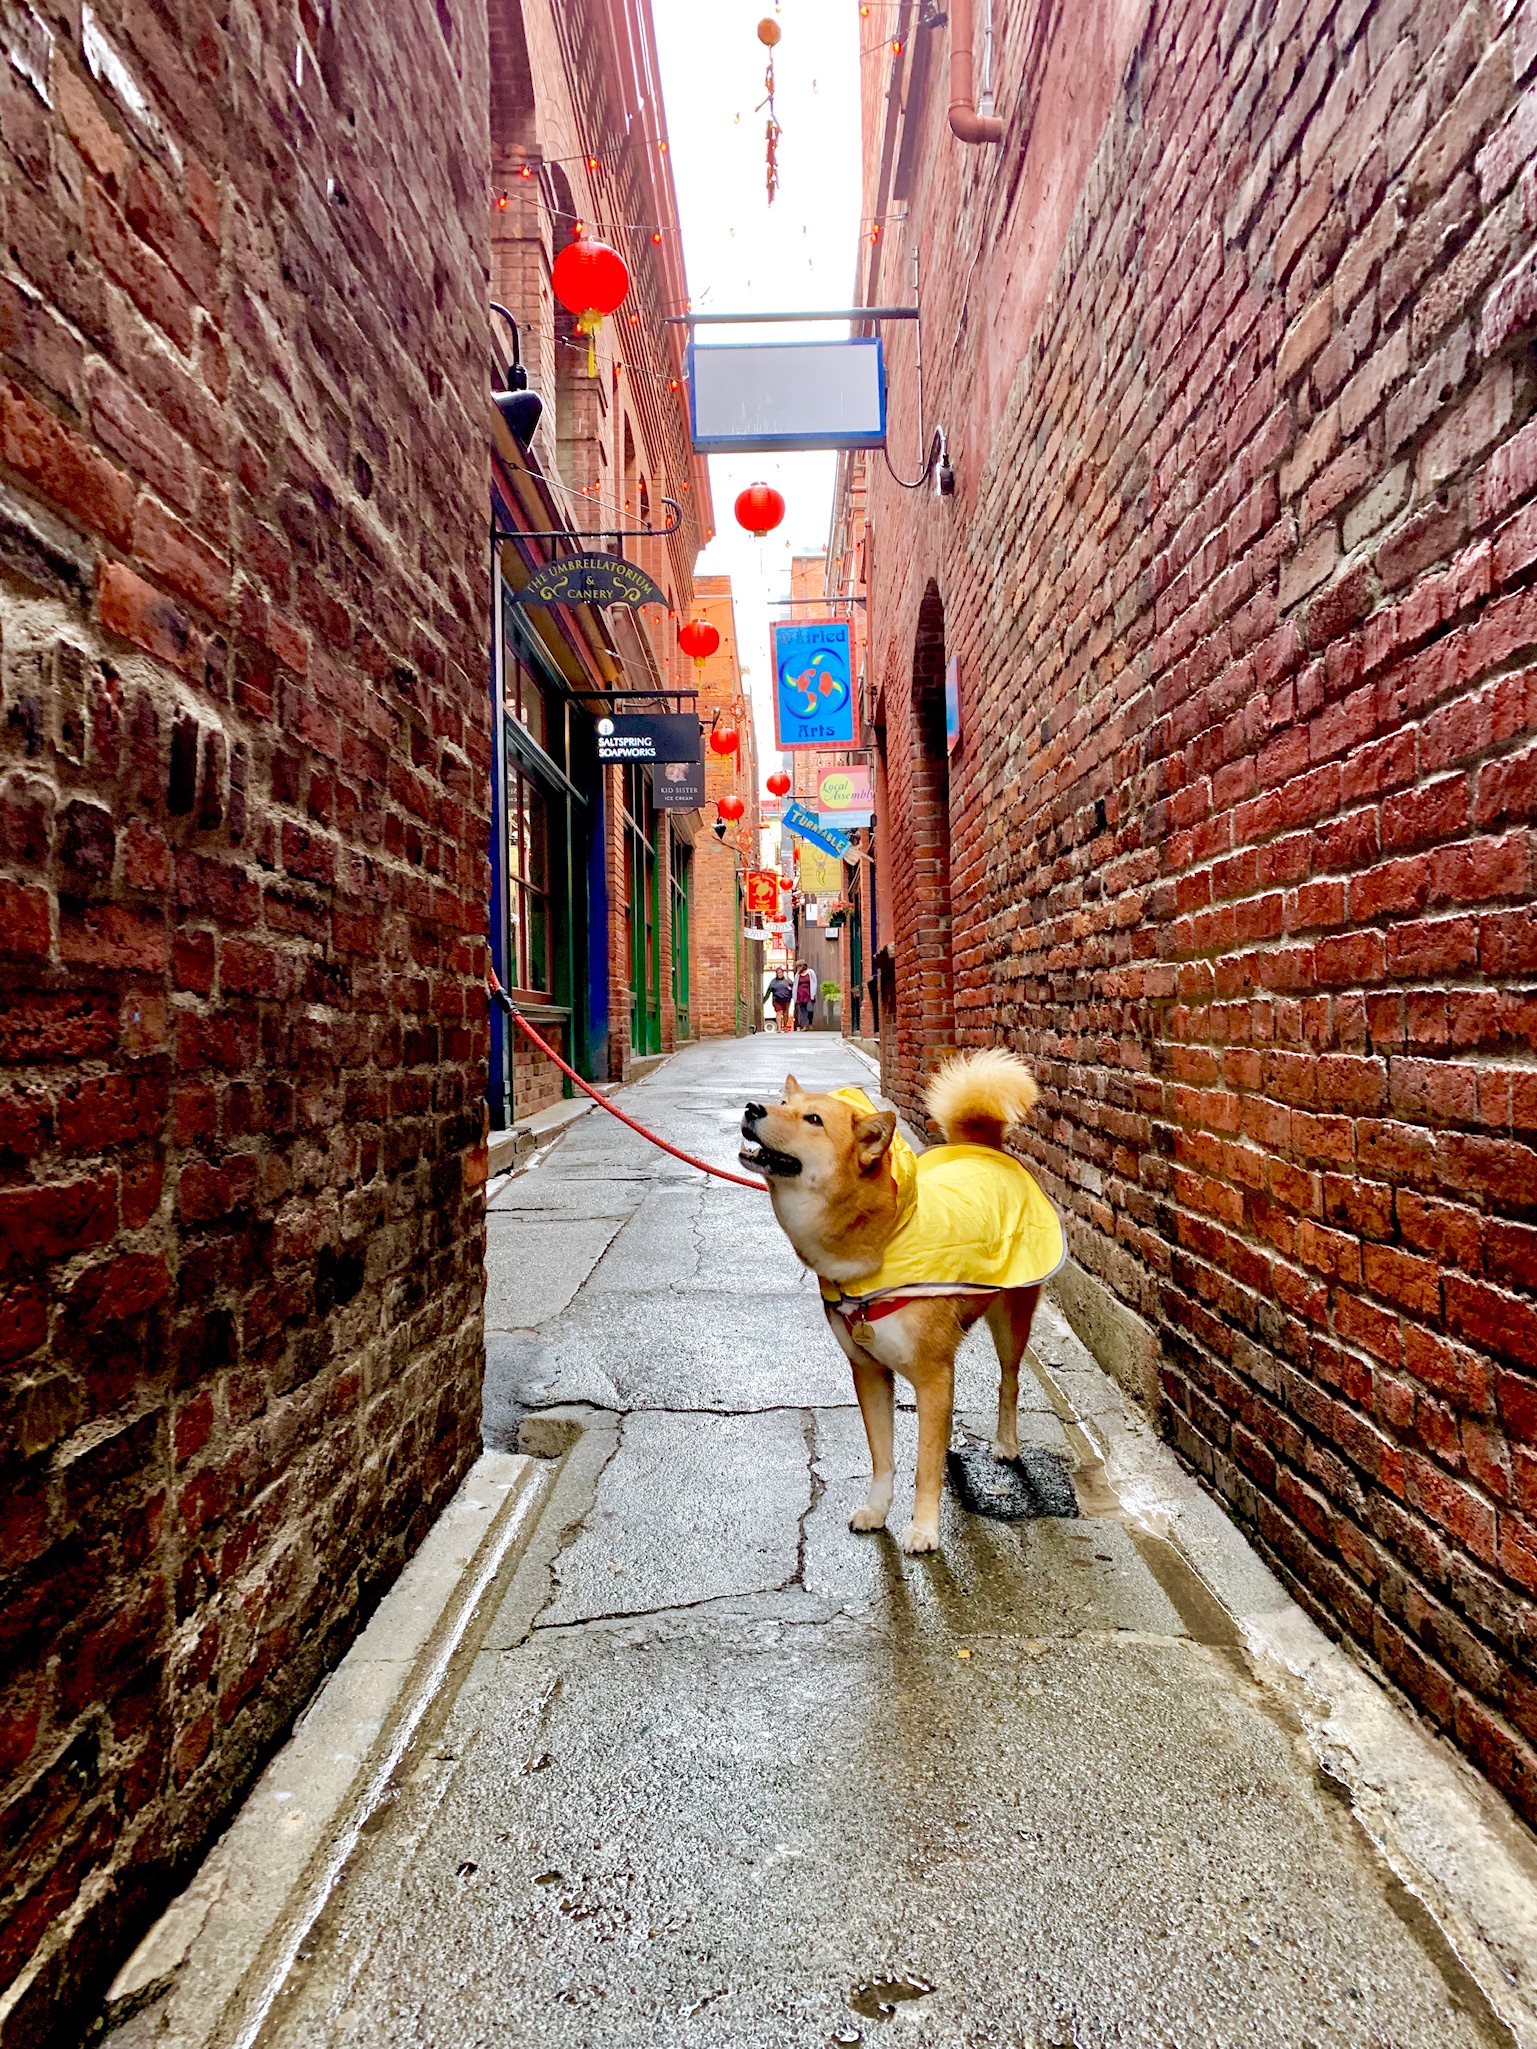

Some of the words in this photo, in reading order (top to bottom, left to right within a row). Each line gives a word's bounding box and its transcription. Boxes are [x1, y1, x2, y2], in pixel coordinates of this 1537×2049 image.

[526, 572, 548, 594] THE
[548, 558, 653, 595] UMBRELLATORIUM
[585, 575, 595, 586] &
[567, 589, 614, 599] CANERY
[798, 724, 835, 738] Arts
[598, 737, 652, 747] SALTSPRING
[598, 747, 656, 758] SOAPWORKS
[822, 780, 848, 793] Local
